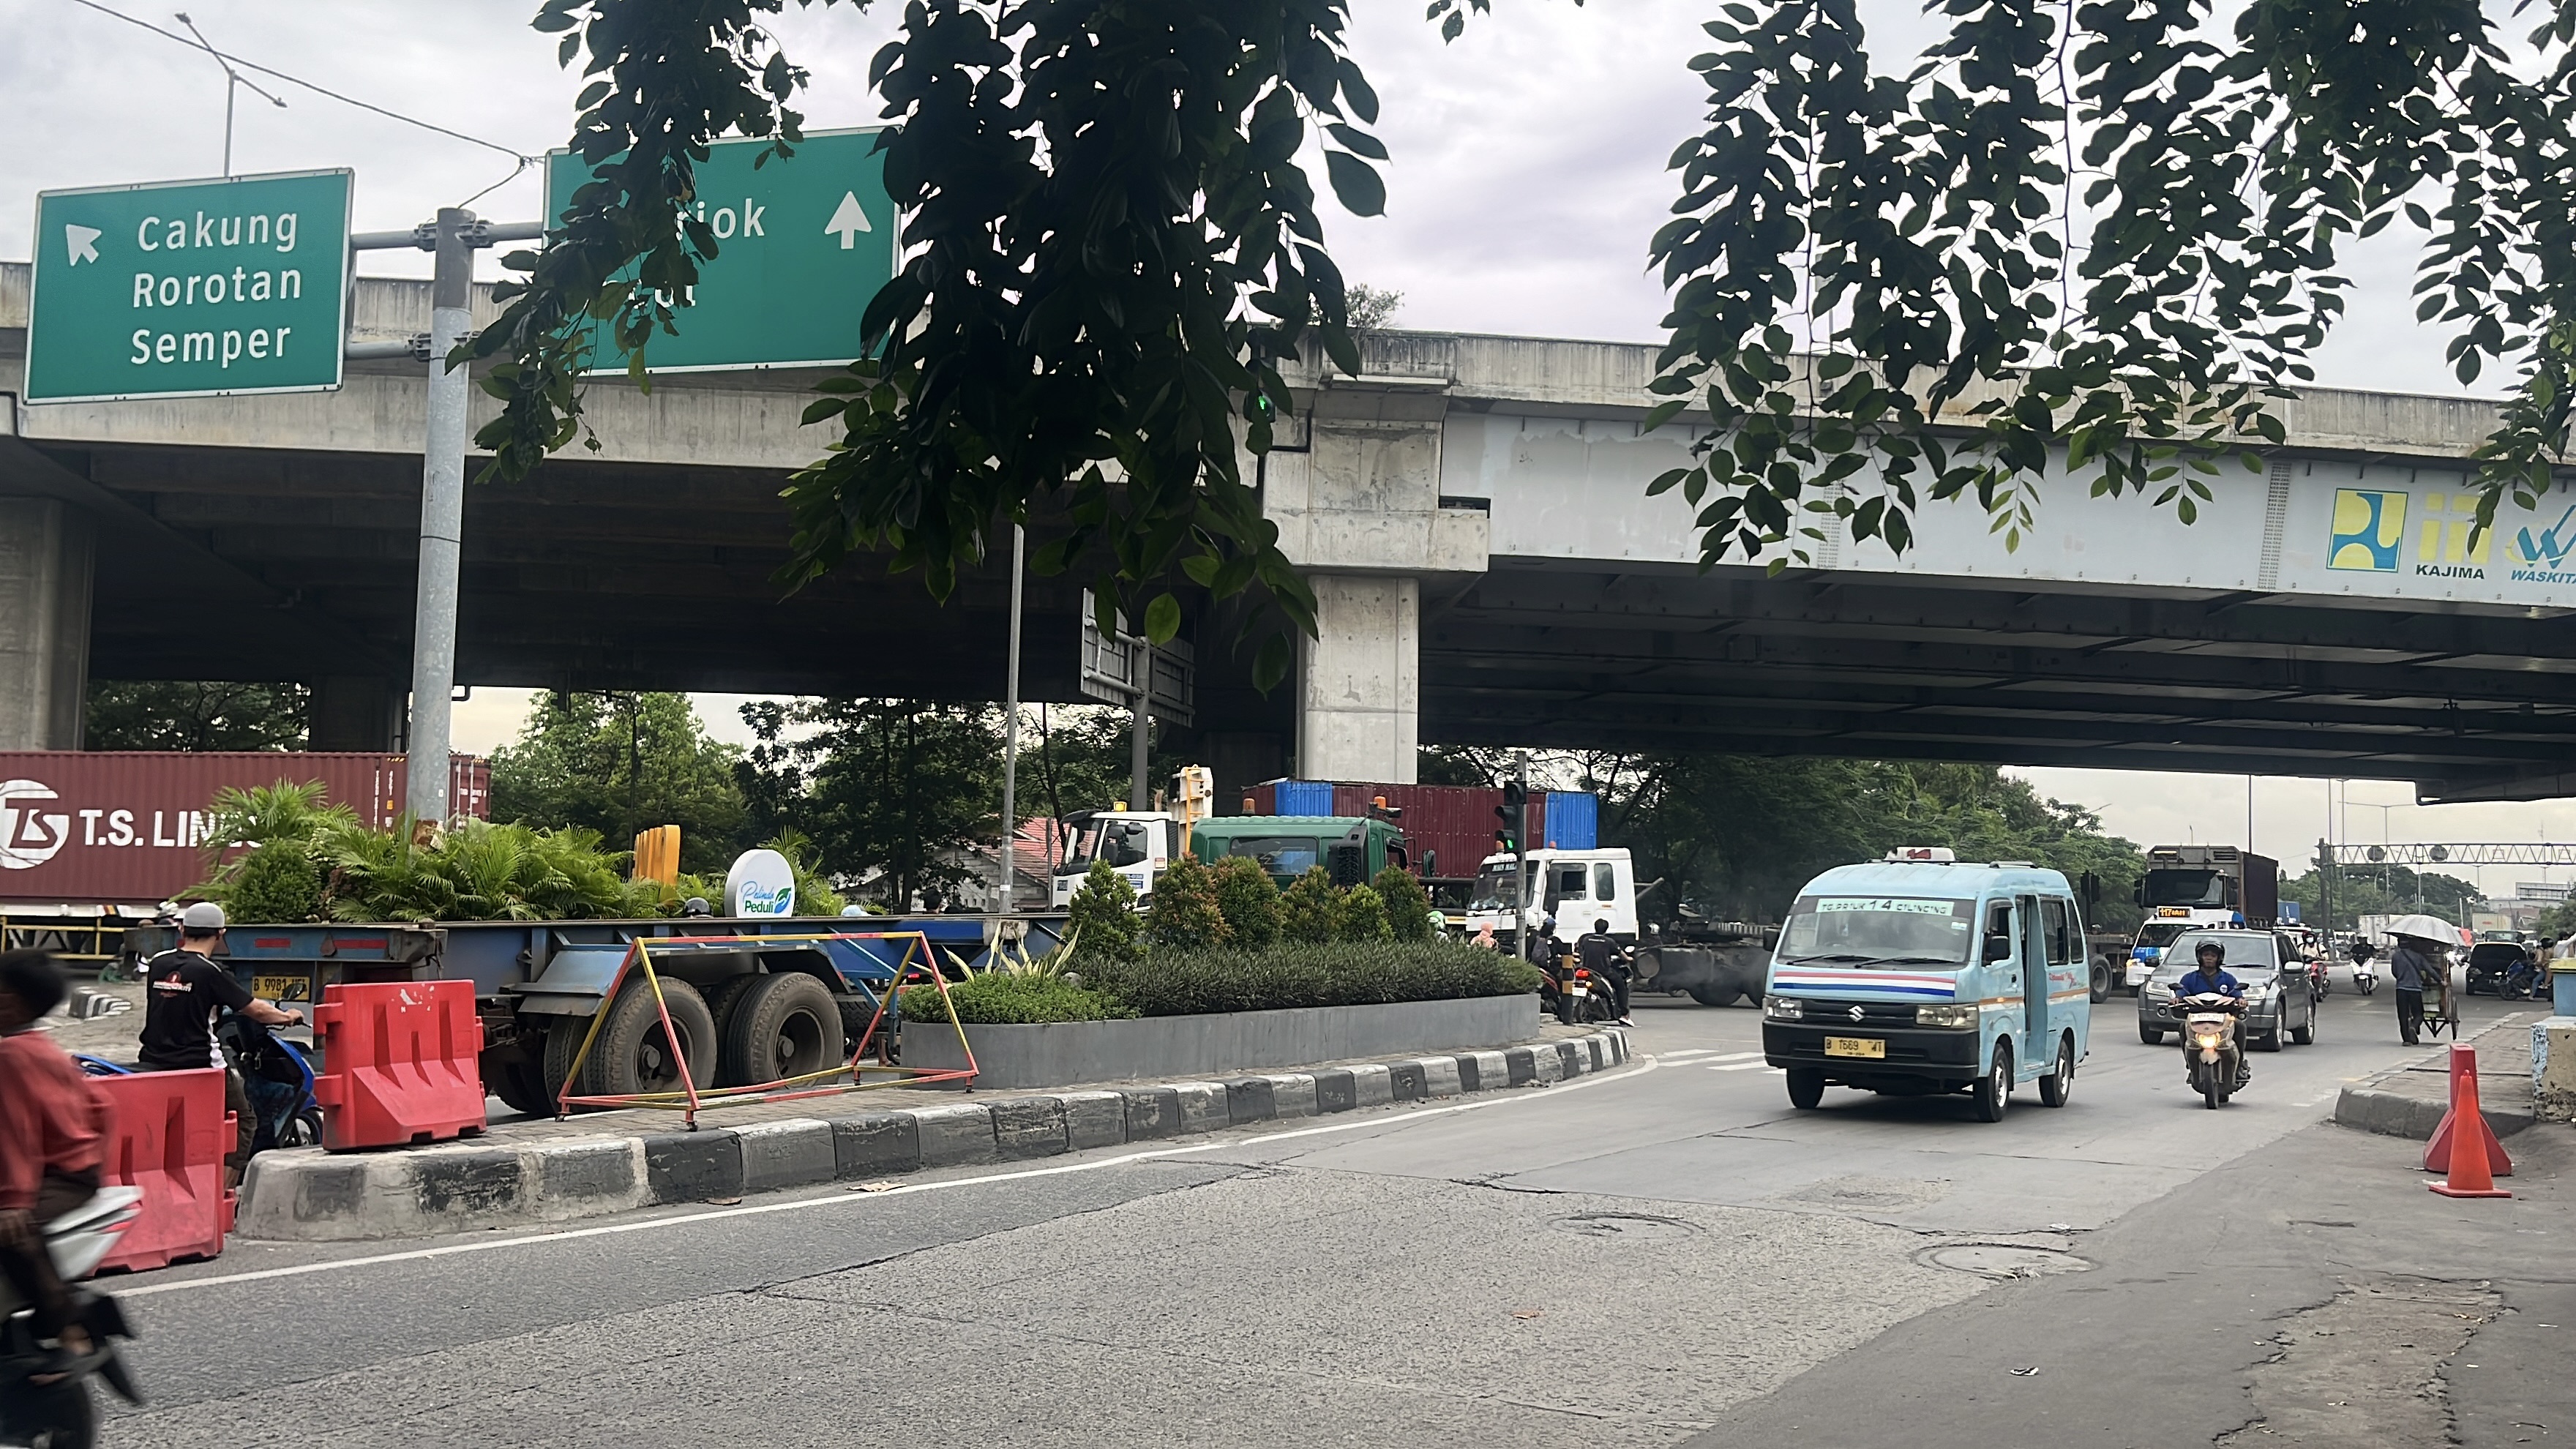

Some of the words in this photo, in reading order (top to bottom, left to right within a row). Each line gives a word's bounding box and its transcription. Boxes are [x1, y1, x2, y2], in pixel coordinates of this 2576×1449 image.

[138, 211, 298, 252] Cakung
[674, 198, 766, 242] riok
[133, 266, 302, 308] Rorotan
[130, 326, 291, 369] Semper
[2415, 564, 2485, 580] KAJIMA
[79, 809, 144, 847] T.S.
[153, 810, 263, 848] LIN
[741, 880, 774, 903] Pelindo
[744, 900, 774, 913] Peduli
[253, 978, 260, 992] B
[265, 978, 287, 992] 9981
[1826, 1038, 1832, 1049] B
